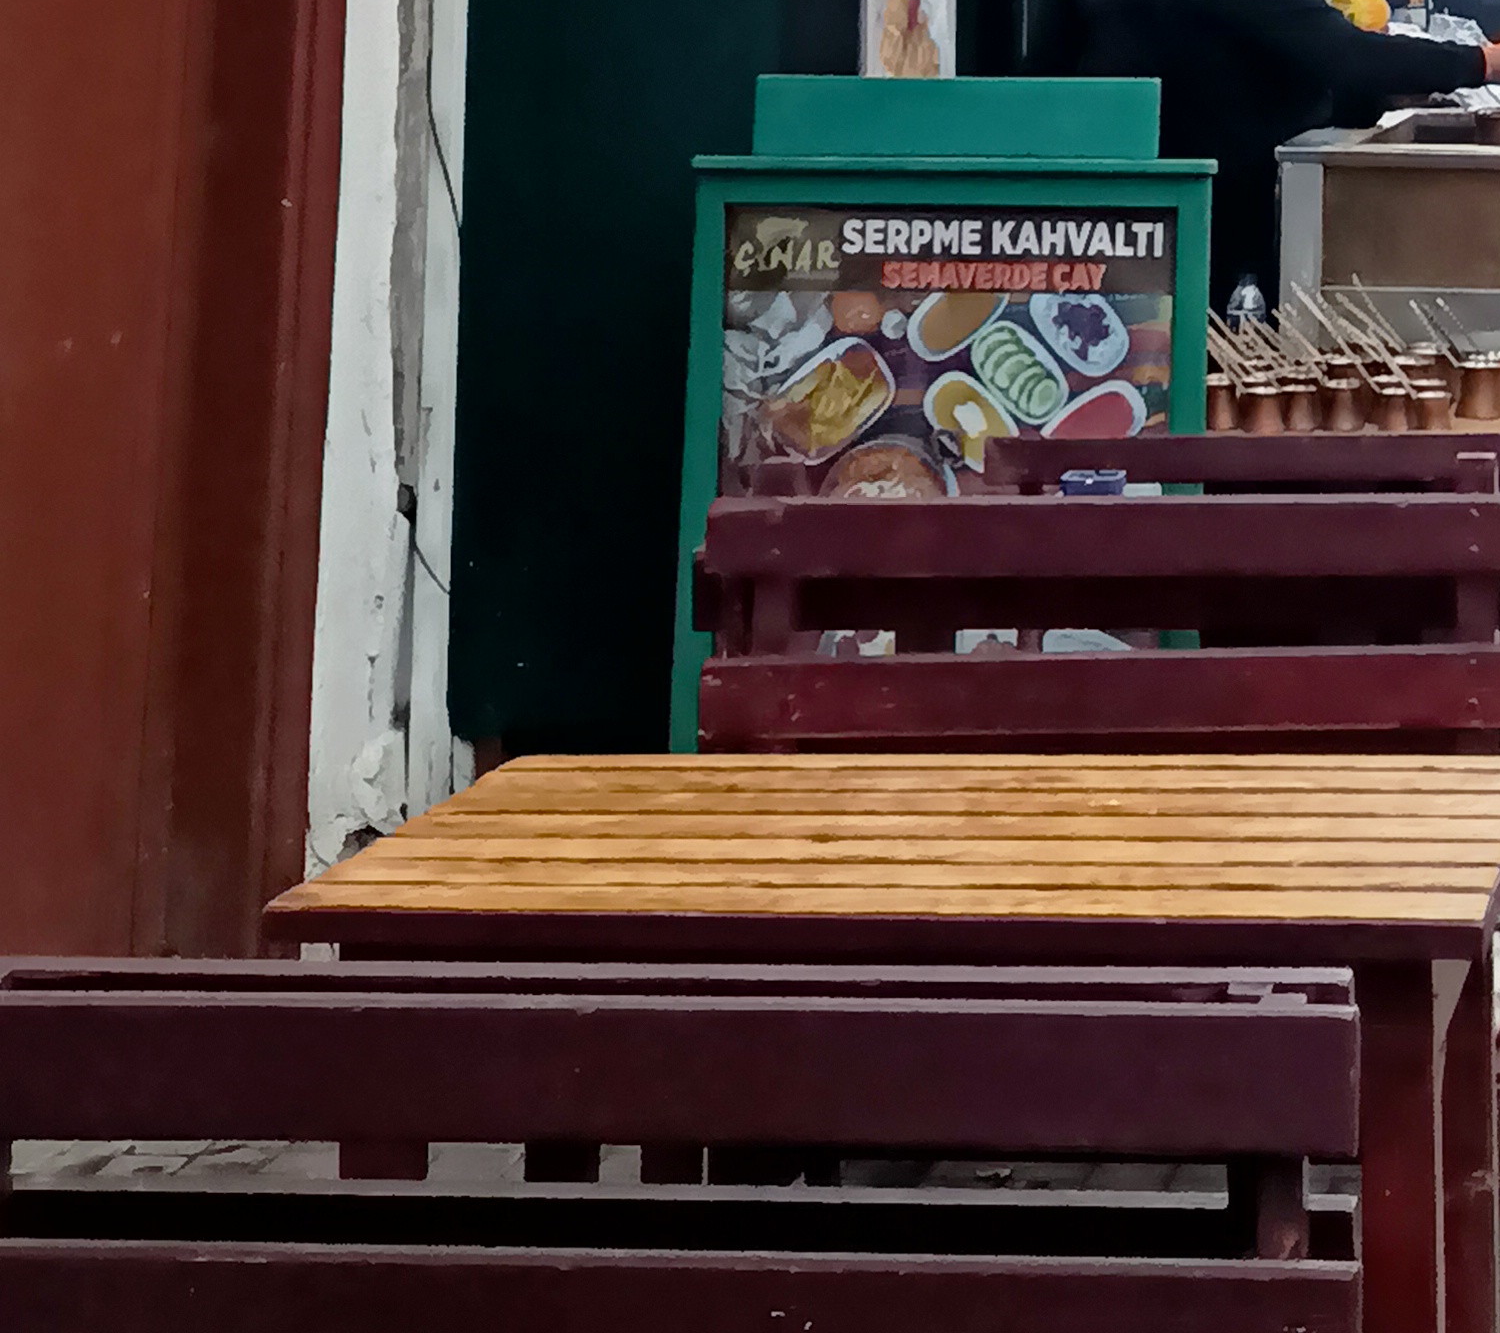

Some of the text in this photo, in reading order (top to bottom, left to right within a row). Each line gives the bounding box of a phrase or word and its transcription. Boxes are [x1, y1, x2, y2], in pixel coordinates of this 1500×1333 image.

[842, 219, 1164, 257] SERPME KAHVALTI
[882, 261, 1048, 290] SEMAVERDE
